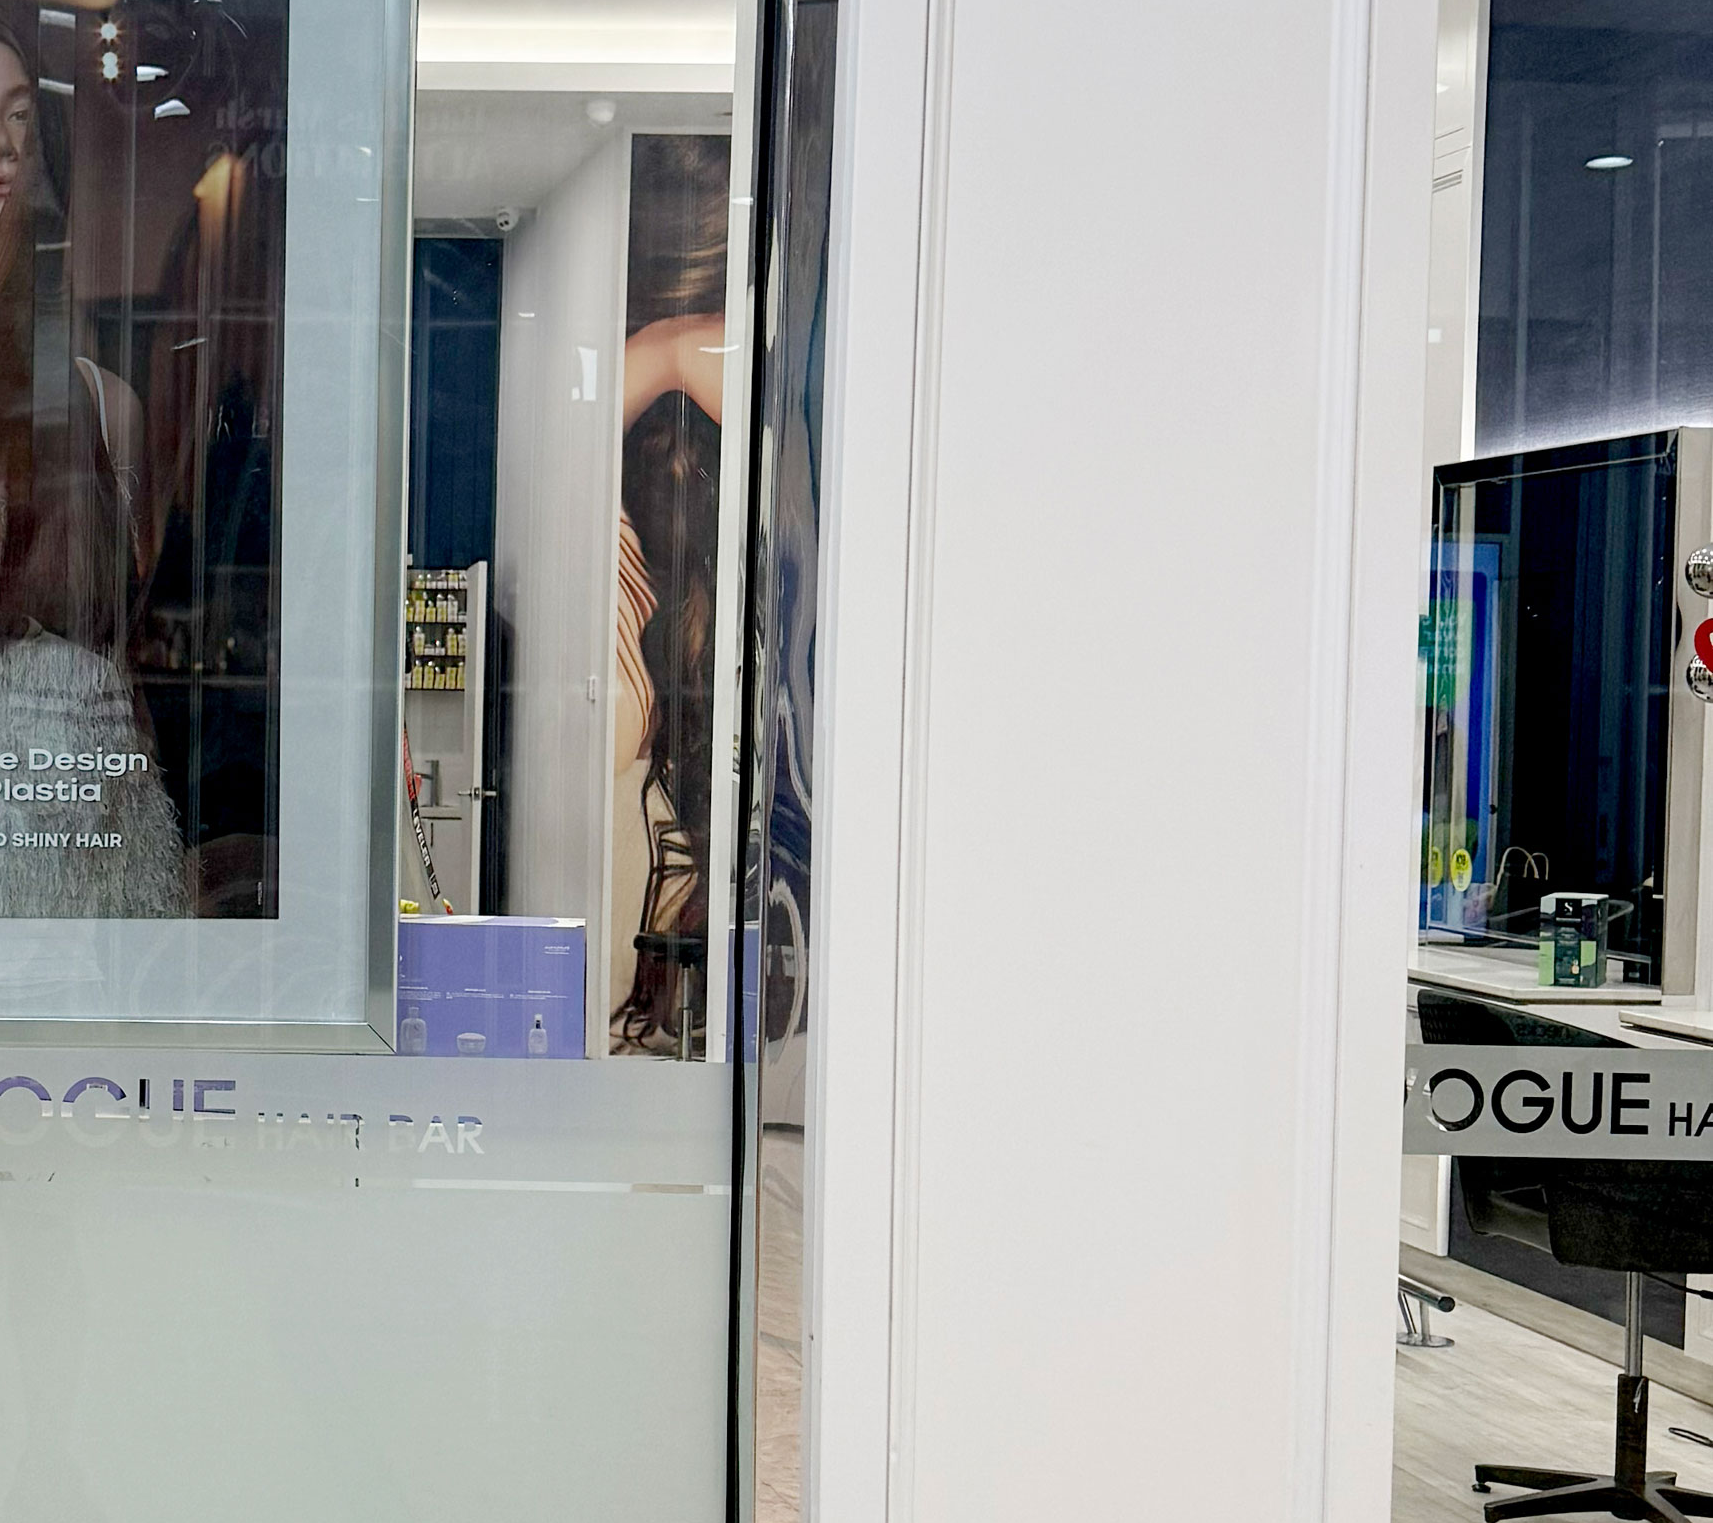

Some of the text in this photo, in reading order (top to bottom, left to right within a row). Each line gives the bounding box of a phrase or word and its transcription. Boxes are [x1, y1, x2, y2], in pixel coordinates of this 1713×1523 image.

[27, 746, 149, 777] Design
[11, 832, 71, 848] SHINY
[75, 833, 124, 848] HAIR
[388, 1114, 485, 1155] BAR
